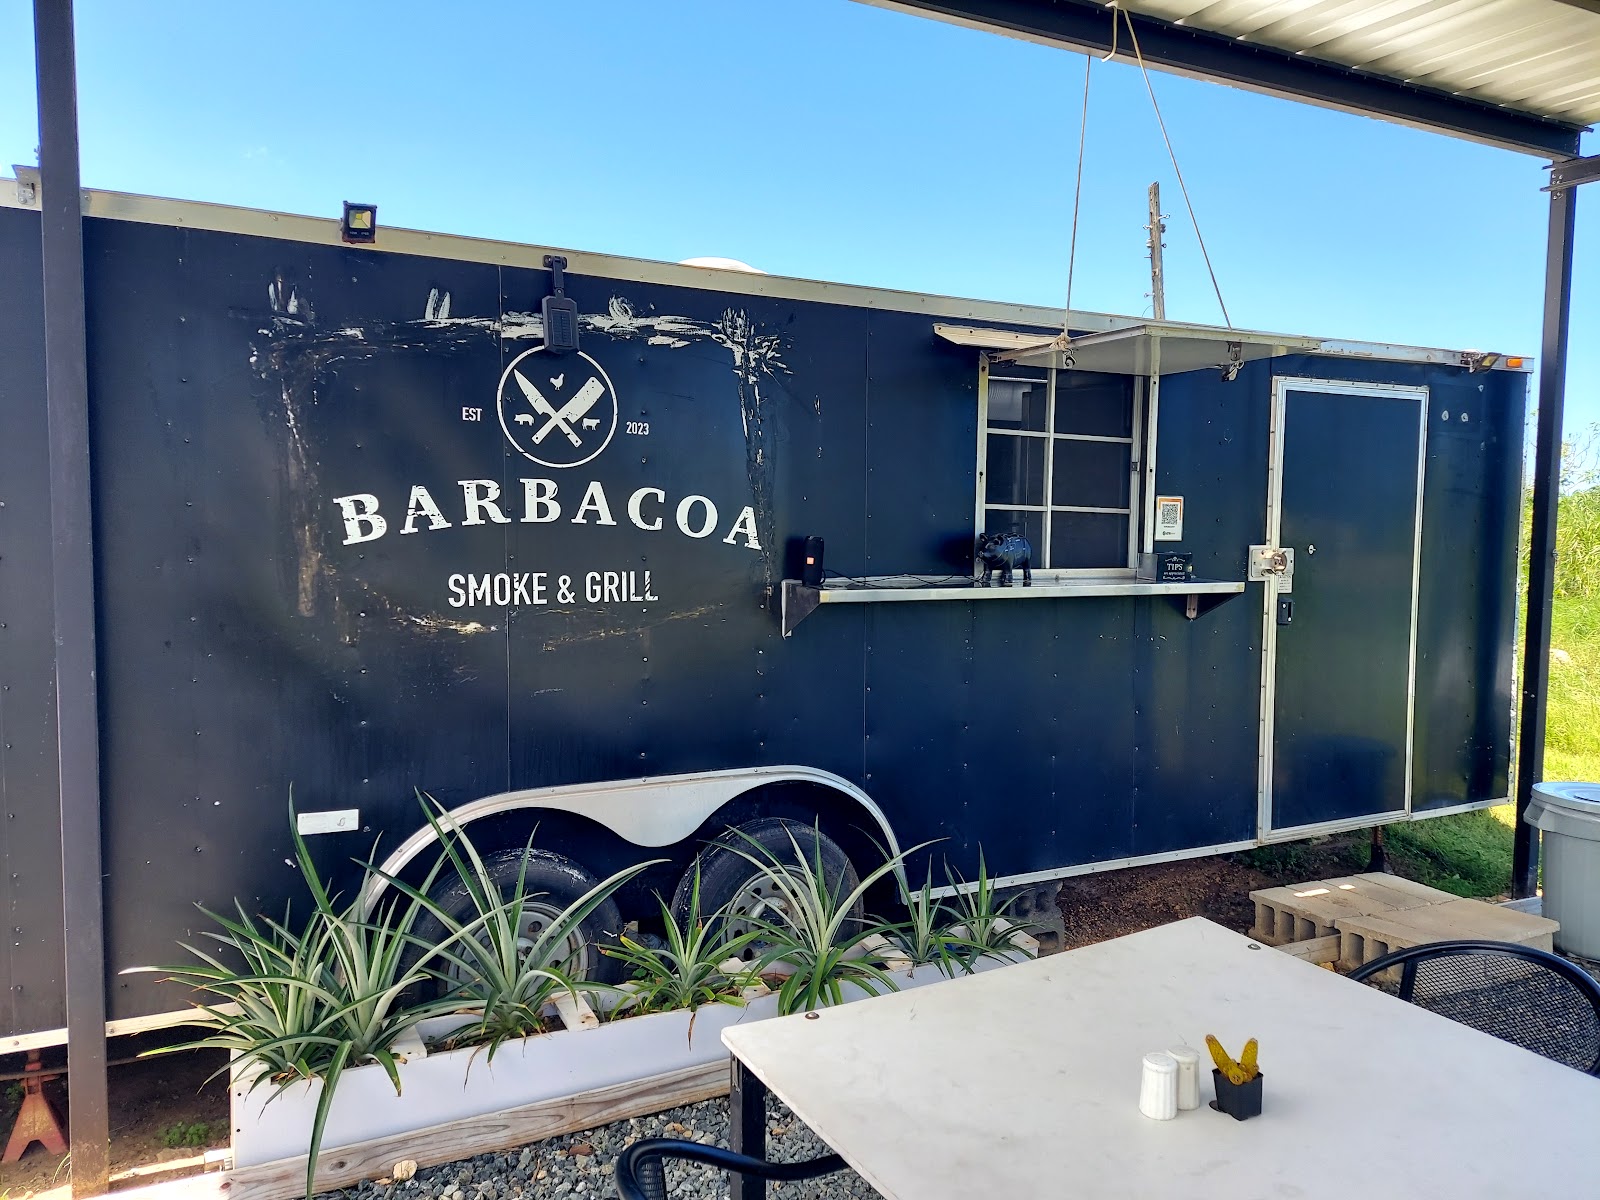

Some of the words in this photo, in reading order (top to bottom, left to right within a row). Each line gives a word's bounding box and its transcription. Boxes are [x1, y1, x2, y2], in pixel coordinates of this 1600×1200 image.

[462, 407, 482, 421] EST
[626, 422, 649, 435] 2023
[333, 478, 761, 549] BARBACOA
[1167, 563, 1183, 571] TIPS
[448, 573, 548, 608] SMOKE
[557, 575, 575, 603] &
[585, 571, 659, 603] GRILL
